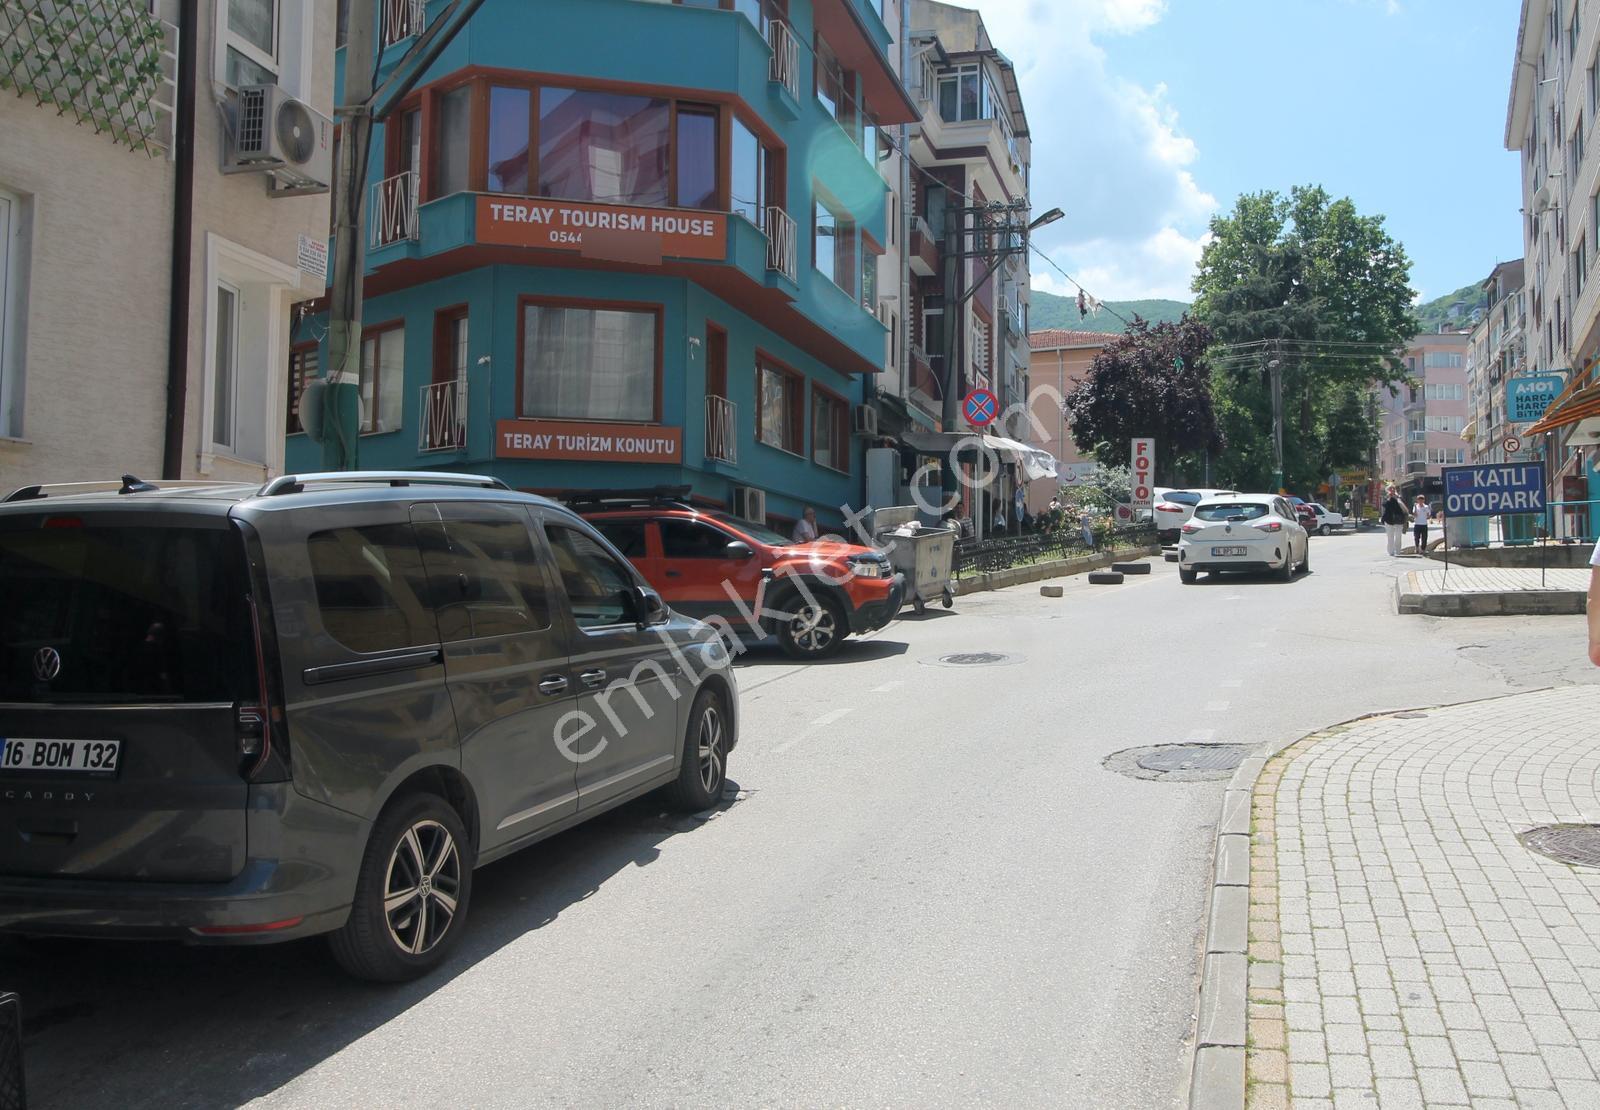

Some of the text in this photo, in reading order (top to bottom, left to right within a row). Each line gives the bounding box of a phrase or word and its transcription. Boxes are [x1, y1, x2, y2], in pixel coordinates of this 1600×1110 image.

[490, 203, 714, 236] TERAY TOURISM HOUSE
[1516, 394, 1554, 402] HARCA
[504, 433, 675, 454] TERAY TURİZM KONUTU
[1135, 442, 1149, 500] FOTO
[1473, 467, 1527, 487] KATLI
[1447, 490, 1542, 512] OTOPARK
[5, 741, 117, 768] 16 BOM 132
[5, 791, 95, 801] CADDY
